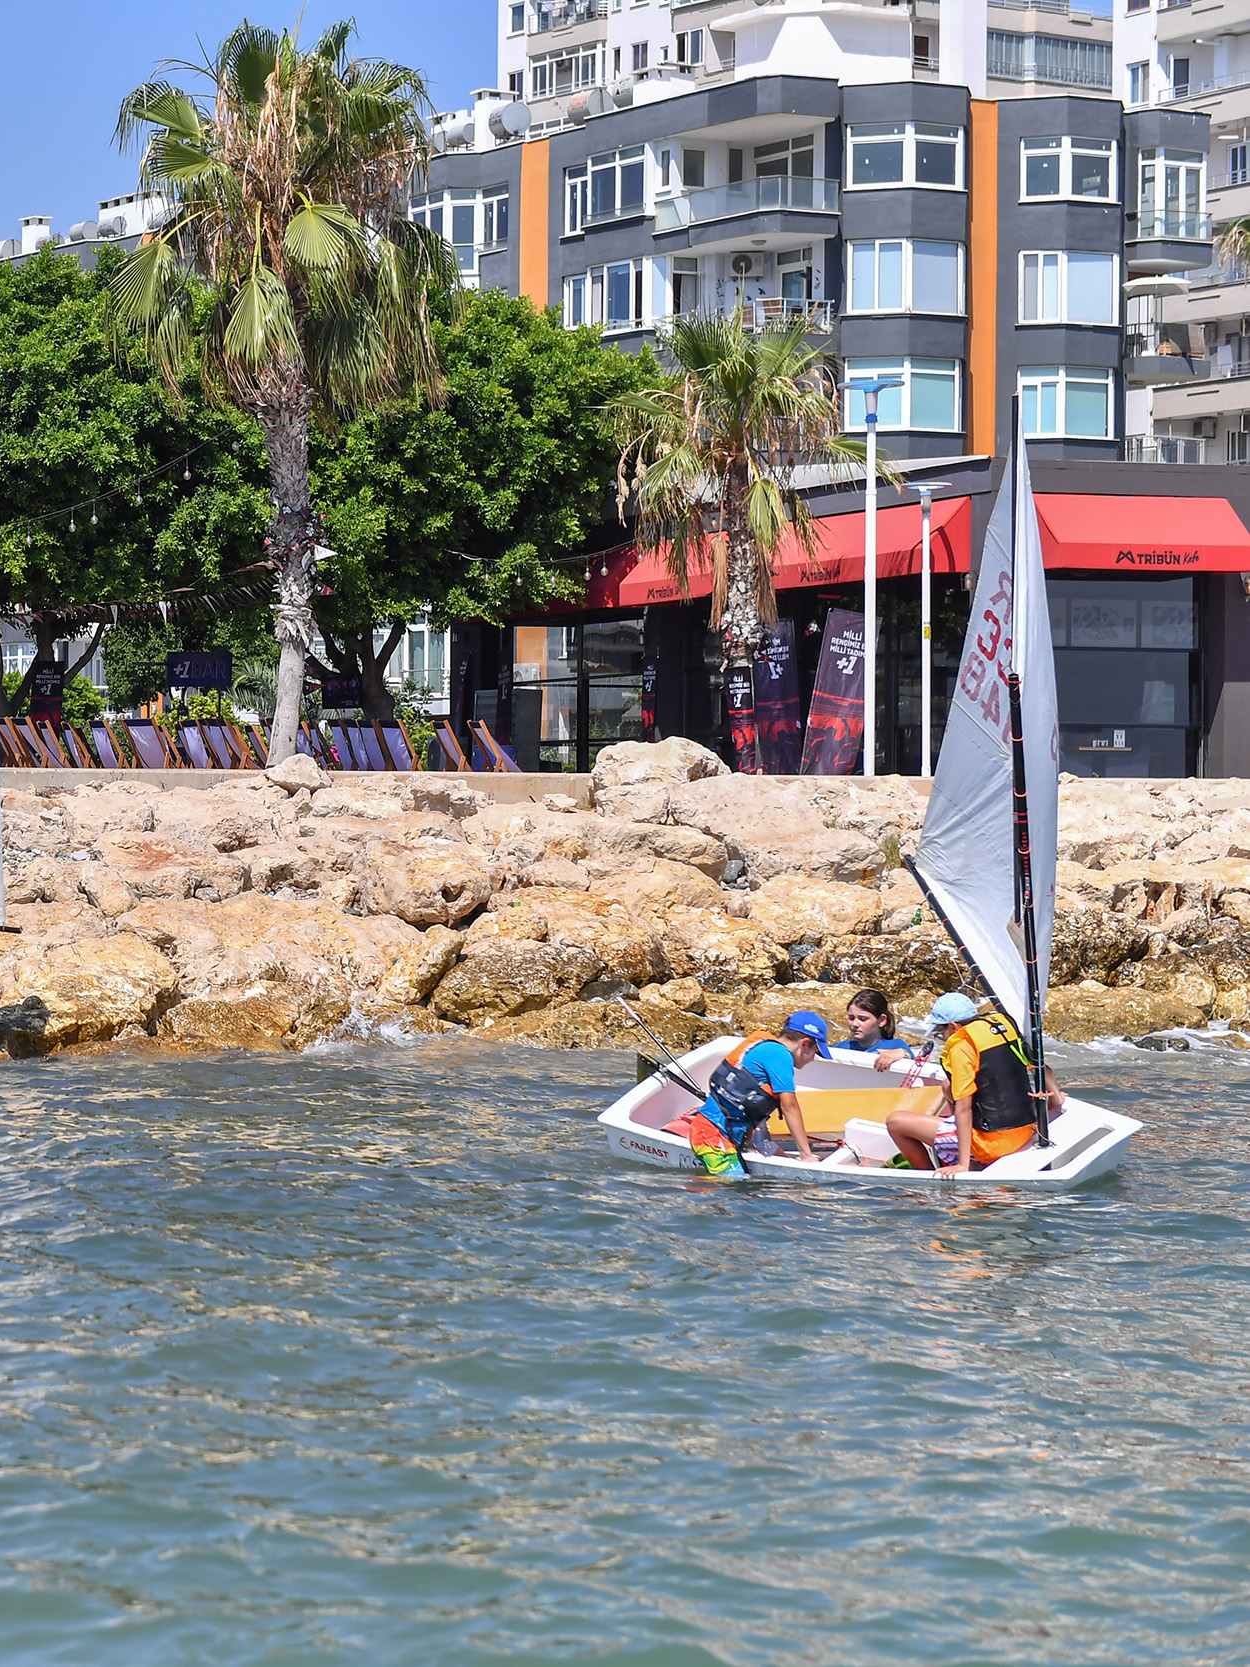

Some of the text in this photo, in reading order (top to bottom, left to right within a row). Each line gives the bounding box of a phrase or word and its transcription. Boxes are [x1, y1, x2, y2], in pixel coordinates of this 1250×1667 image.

[1137, 551, 1181, 565] TRİBÜN
[843, 630, 863, 641] MİLLİ
[831, 637, 861, 649] RENGİMİZ
[836, 656, 858, 675] +1
[629, 1140, 670, 1159] FAREAST
